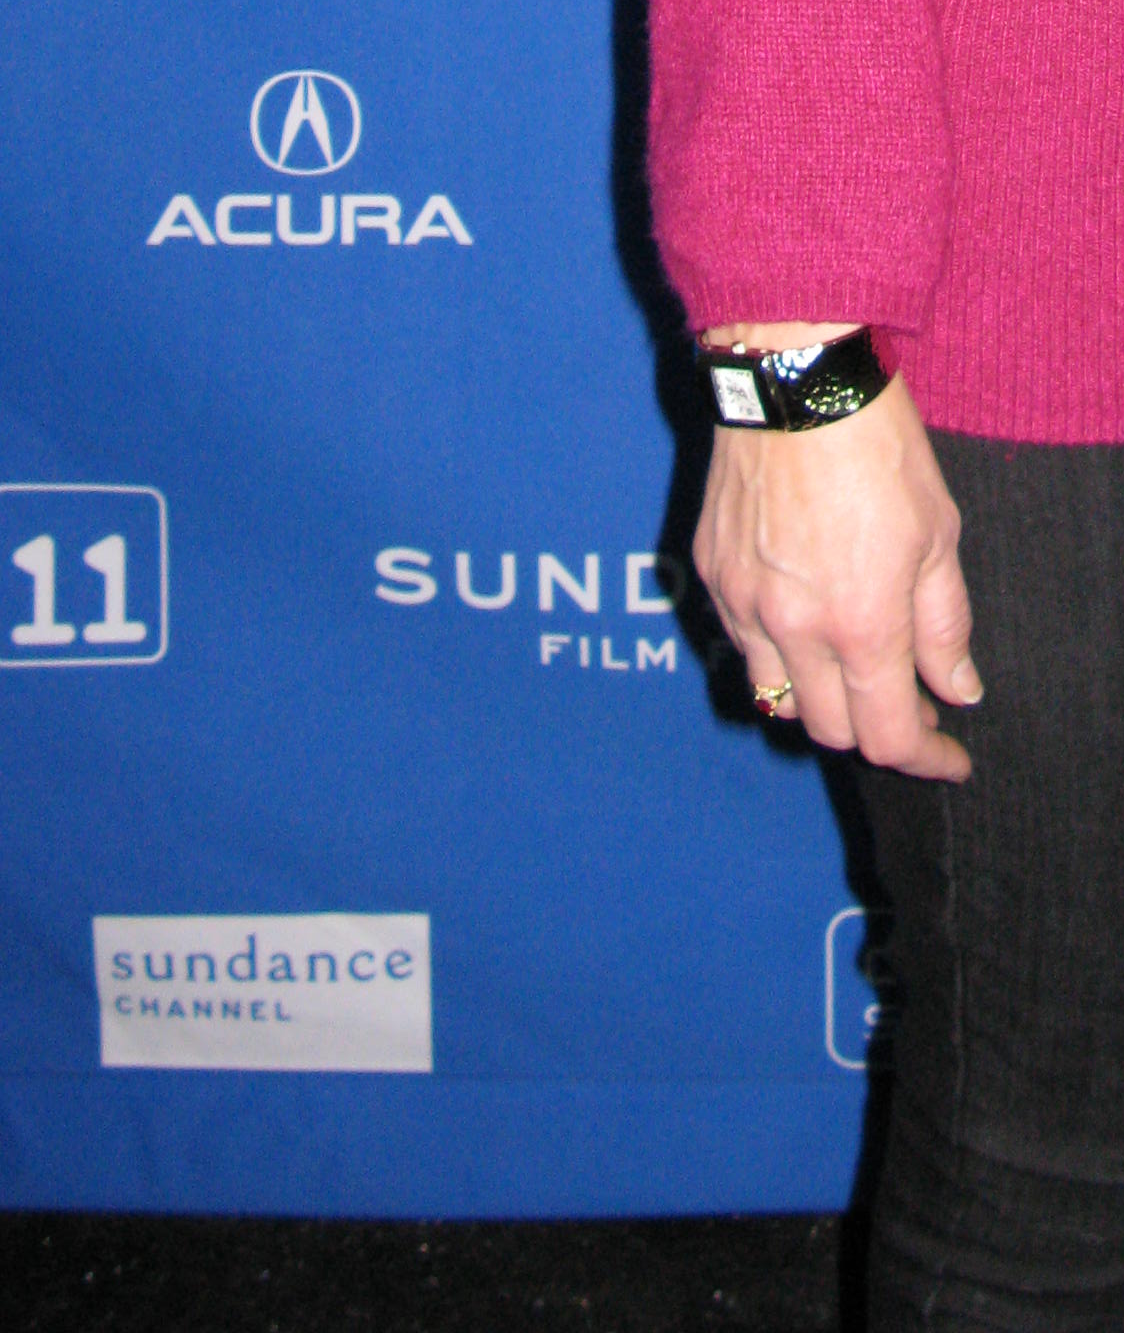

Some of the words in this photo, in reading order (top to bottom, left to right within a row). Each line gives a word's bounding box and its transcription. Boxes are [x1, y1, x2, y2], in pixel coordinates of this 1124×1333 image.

[146, 194, 473, 245] ACURA
[12, 535, 147, 645] 11
[541, 635, 676, 672] FILM
[111, 932, 413, 984] sundance
[115, 995, 292, 1023] CHANNEL
